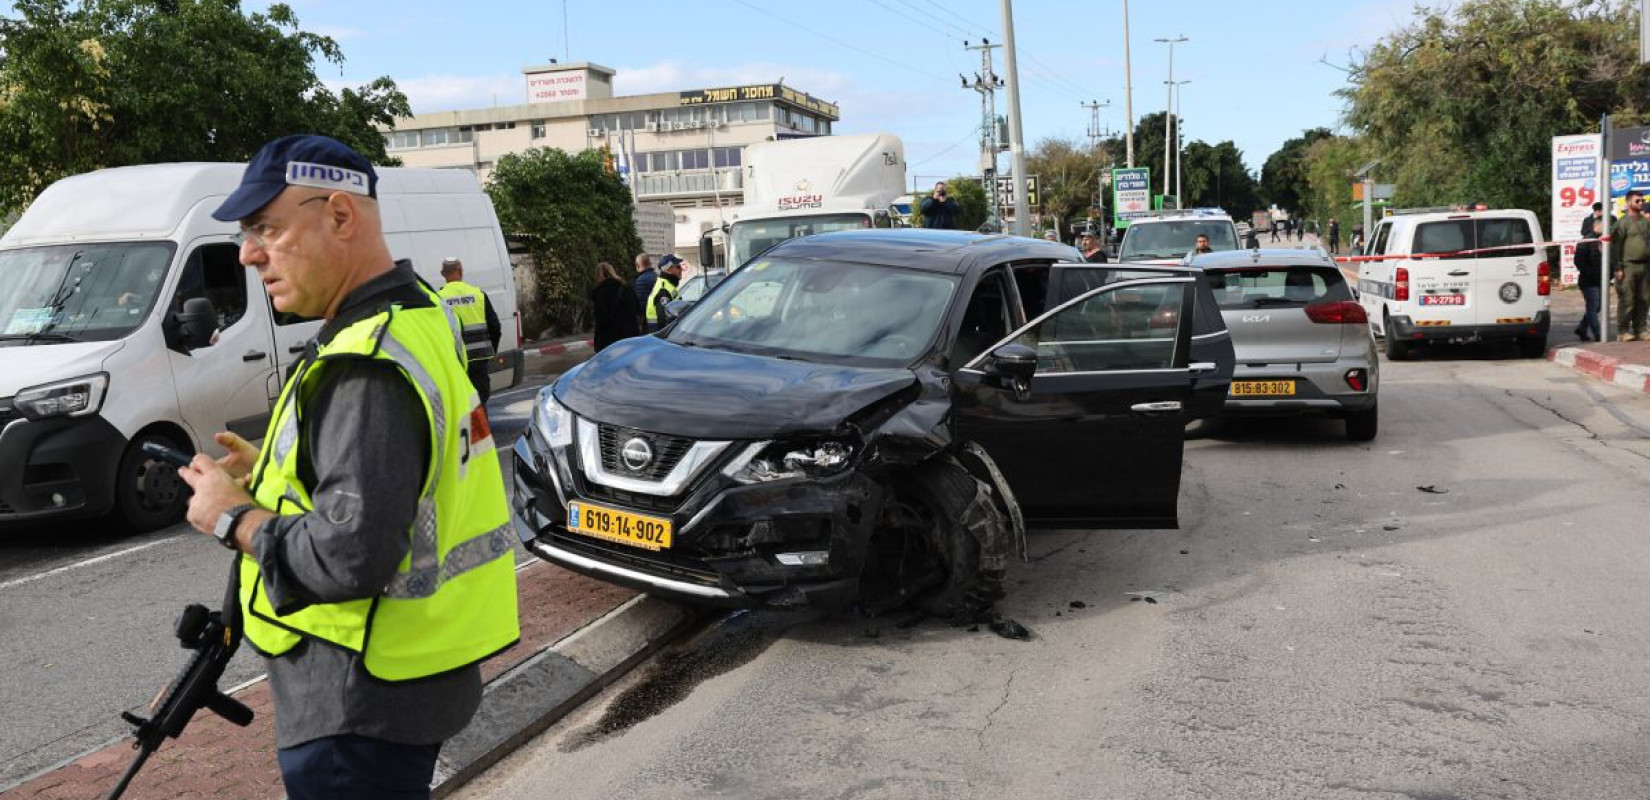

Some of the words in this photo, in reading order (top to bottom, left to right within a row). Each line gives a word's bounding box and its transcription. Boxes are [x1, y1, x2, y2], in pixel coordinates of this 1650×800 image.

[704, 88, 738, 102] חשמל
[741, 85, 774, 98] מחסני
[1557, 143, 1595, 155] Express
[1611, 160, 1648, 172] גלידה
[292, 164, 364, 187] ביטחון
[778, 194, 823, 206] ISUZU
[1560, 187, 1595, 208] 99
